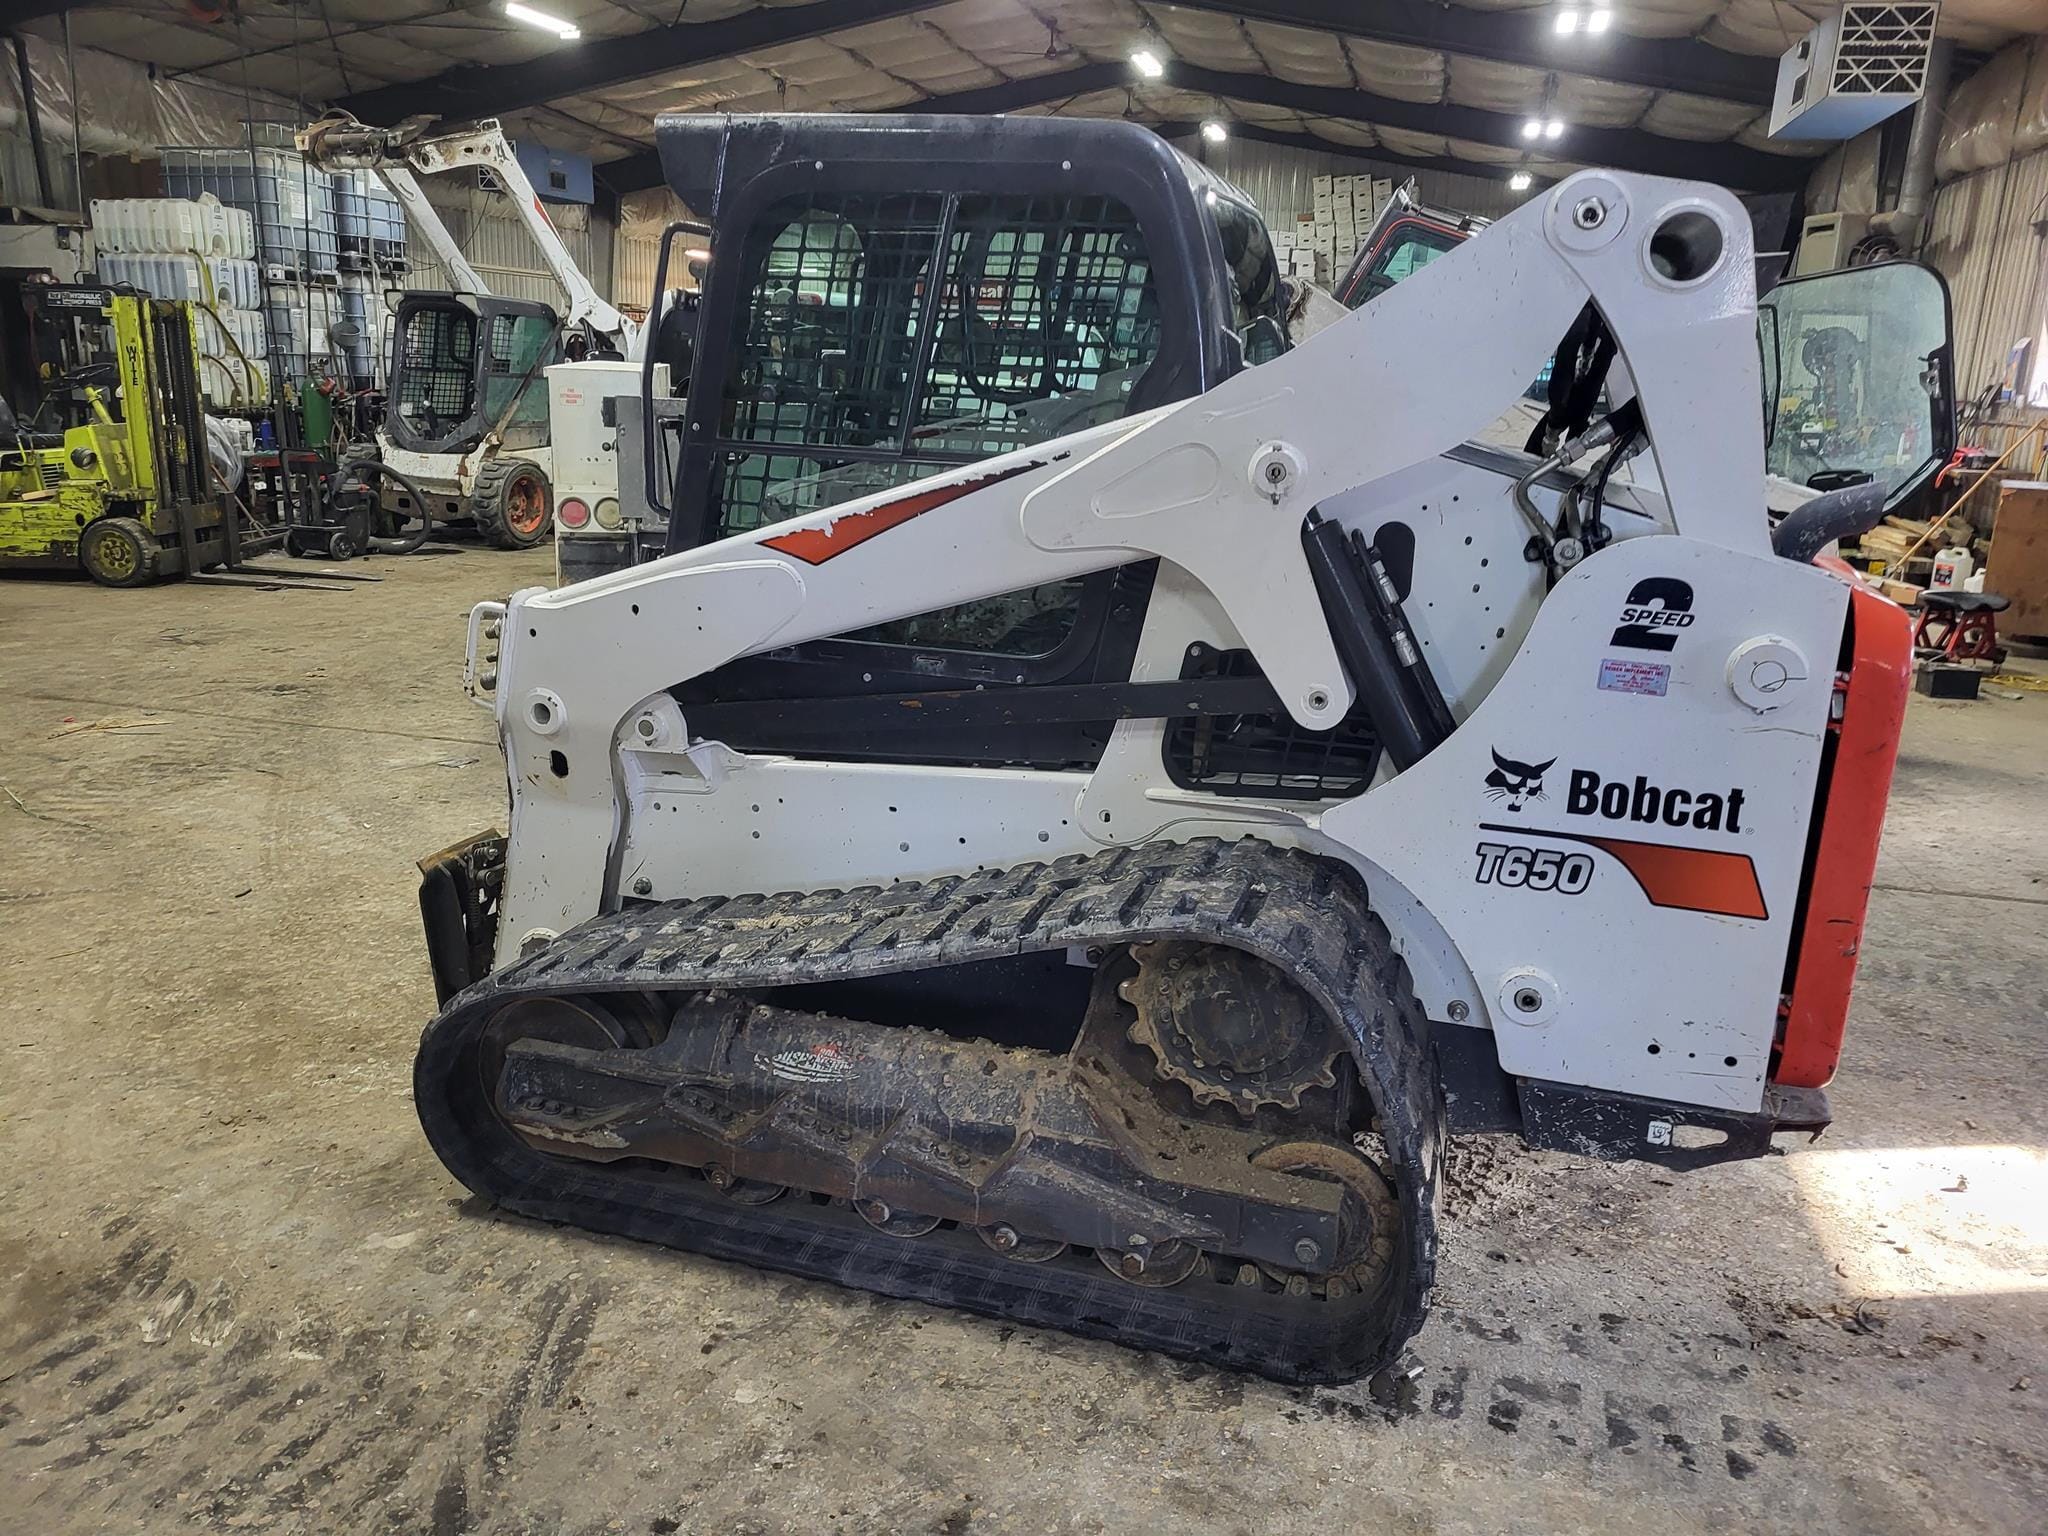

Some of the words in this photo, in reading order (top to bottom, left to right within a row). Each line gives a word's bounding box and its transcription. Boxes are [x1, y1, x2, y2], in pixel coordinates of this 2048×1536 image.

[125, 345, 139, 386] WHITE
[1609, 577, 1694, 652] 2
[1619, 608, 1696, 628] SPEED
[1566, 768, 1746, 834] Bobcat
[1475, 842, 1595, 895] T650
